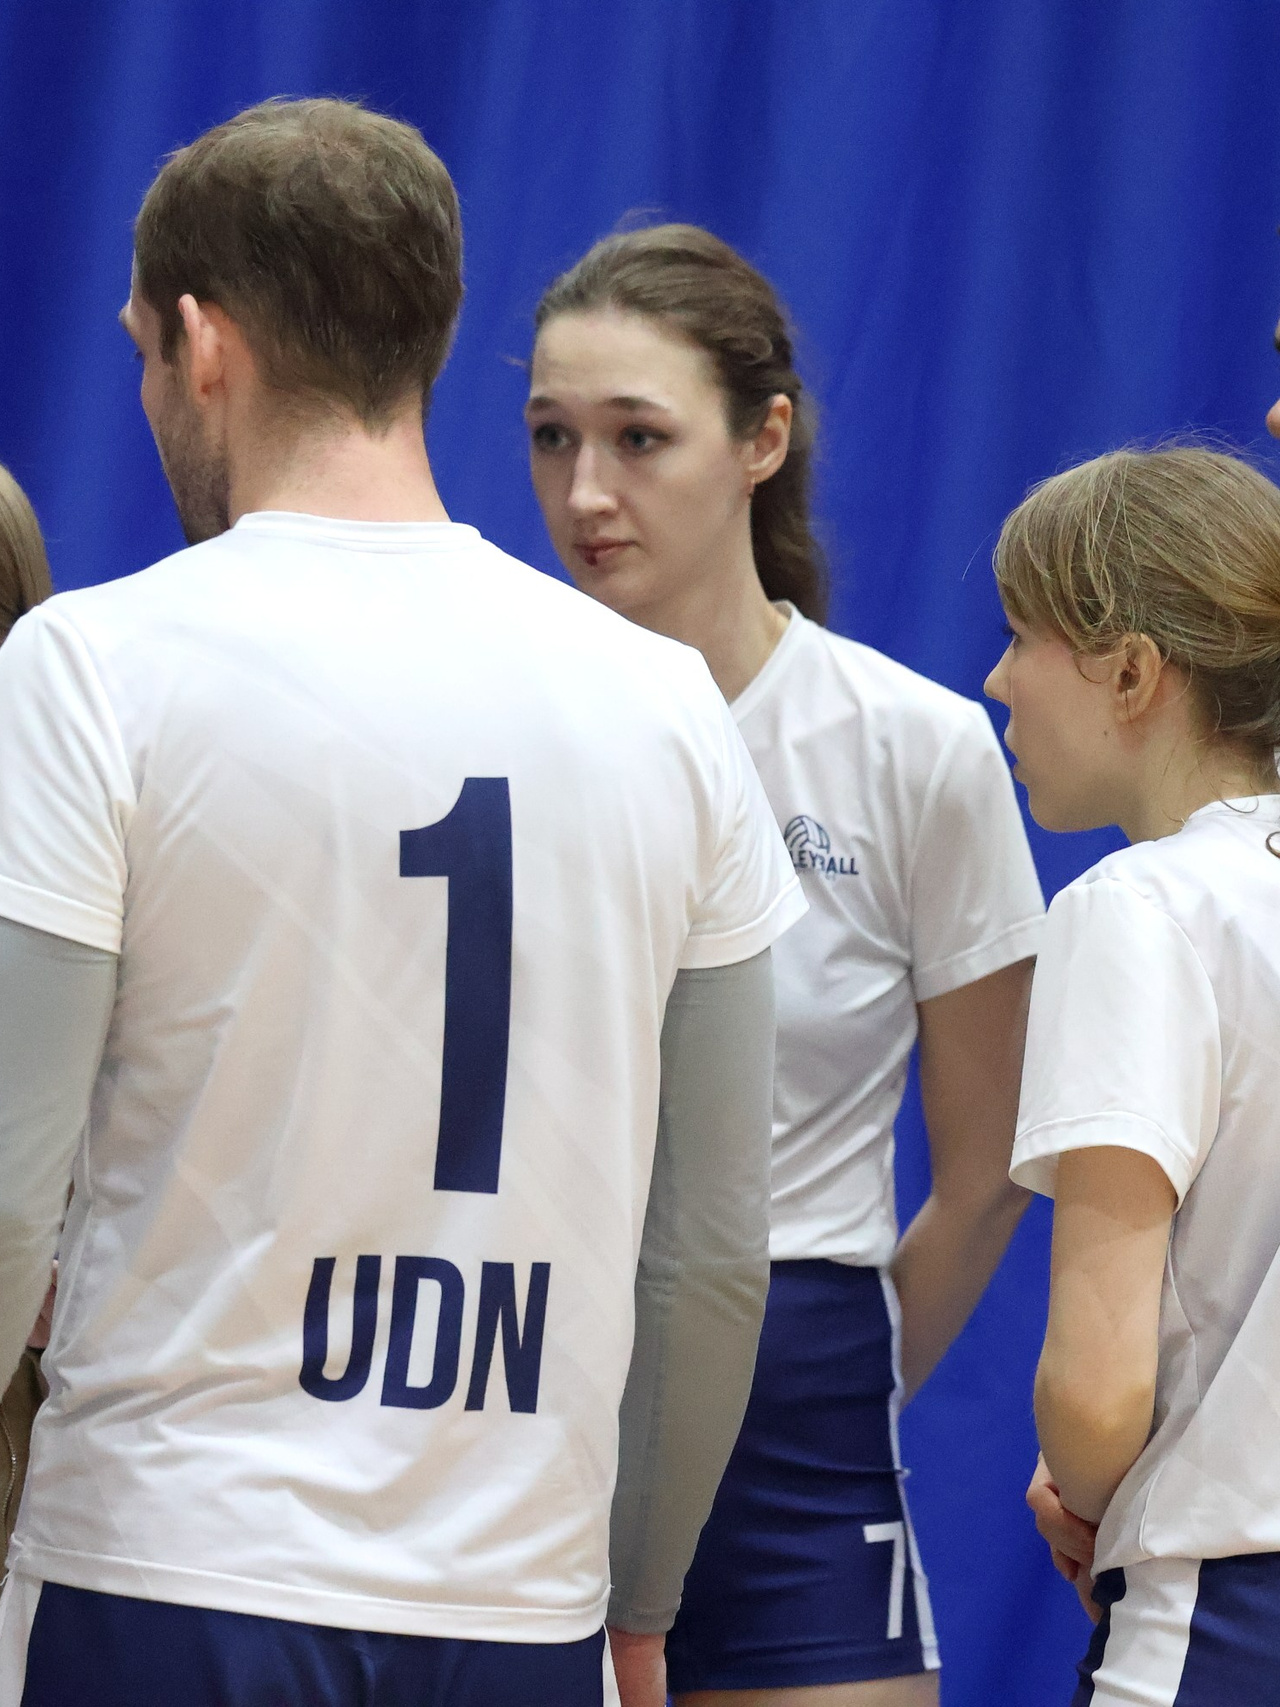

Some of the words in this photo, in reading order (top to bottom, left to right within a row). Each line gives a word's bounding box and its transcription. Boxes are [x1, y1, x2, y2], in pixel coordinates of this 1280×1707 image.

[399, 777, 513, 1194] 1
[298, 1255, 551, 1414] UDN
[862, 1520, 906, 1640] 7
